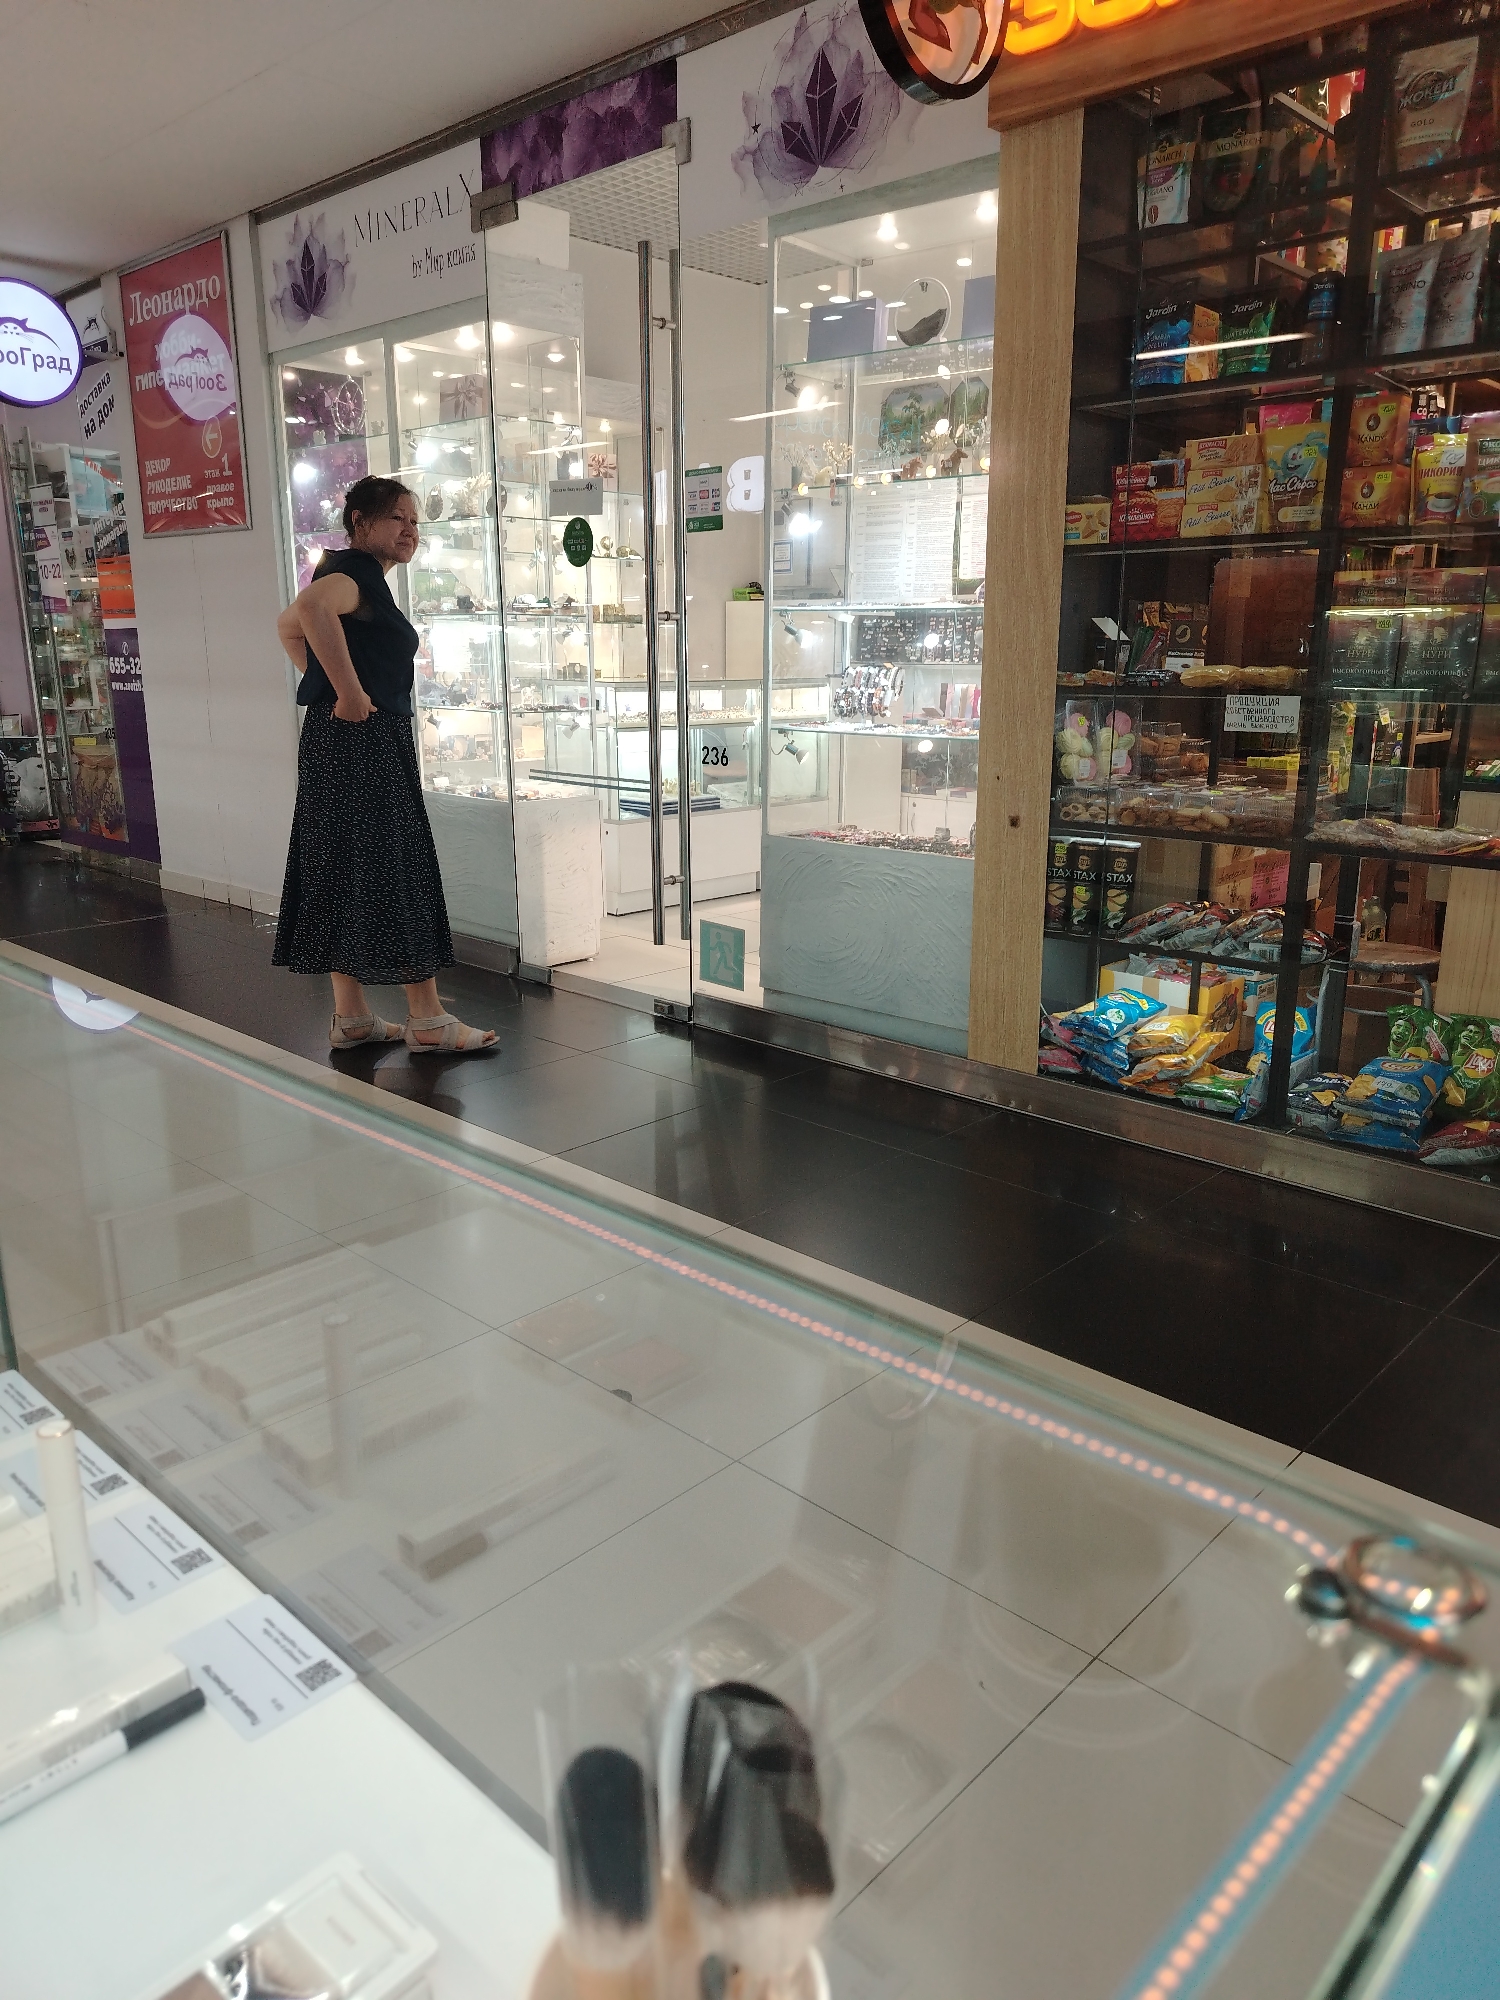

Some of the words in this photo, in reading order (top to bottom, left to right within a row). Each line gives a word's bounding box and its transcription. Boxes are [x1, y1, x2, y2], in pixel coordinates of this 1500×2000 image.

[1410, 118, 1435, 128] GOLD
[1215, 137, 1263, 152] MONARCH
[412, 254, 423, 278] by
[425, 246, 445, 279] Мир
[447, 243, 476, 269] камня
[129, 275, 221, 327] Леонардо
[1232, 300, 1263, 314] Jardin
[1145, 303, 1178, 320] Jardin
[79, 372, 111, 419] доставка
[83, 417, 97, 440] на
[145, 458, 171, 477] ДЕКОР
[204, 468, 221, 479] этаж
[222, 453, 233, 476] 1
[147, 475, 192, 495] РУКОДЕЛИЕ
[207, 482, 235, 496] правое
[148, 496, 199, 515] ТВОРЧЕСТВО
[207, 496, 235, 510] крыло
[39, 563, 62, 579] 10-22
[1421, 650, 1452, 659] НУРИ
[1229, 696, 1280, 707] ПРОДУКЦИЯ
[1226, 706, 1276, 715] СОБСТВЕННОГО
[1243, 714, 1295, 724] ПРОИЗВОДСТВА
[702, 745, 729, 767] 236
[1048, 868, 1072, 878] STAX
[1074, 870, 1097, 881] STAX
[1106, 873, 1134, 883] STAX
